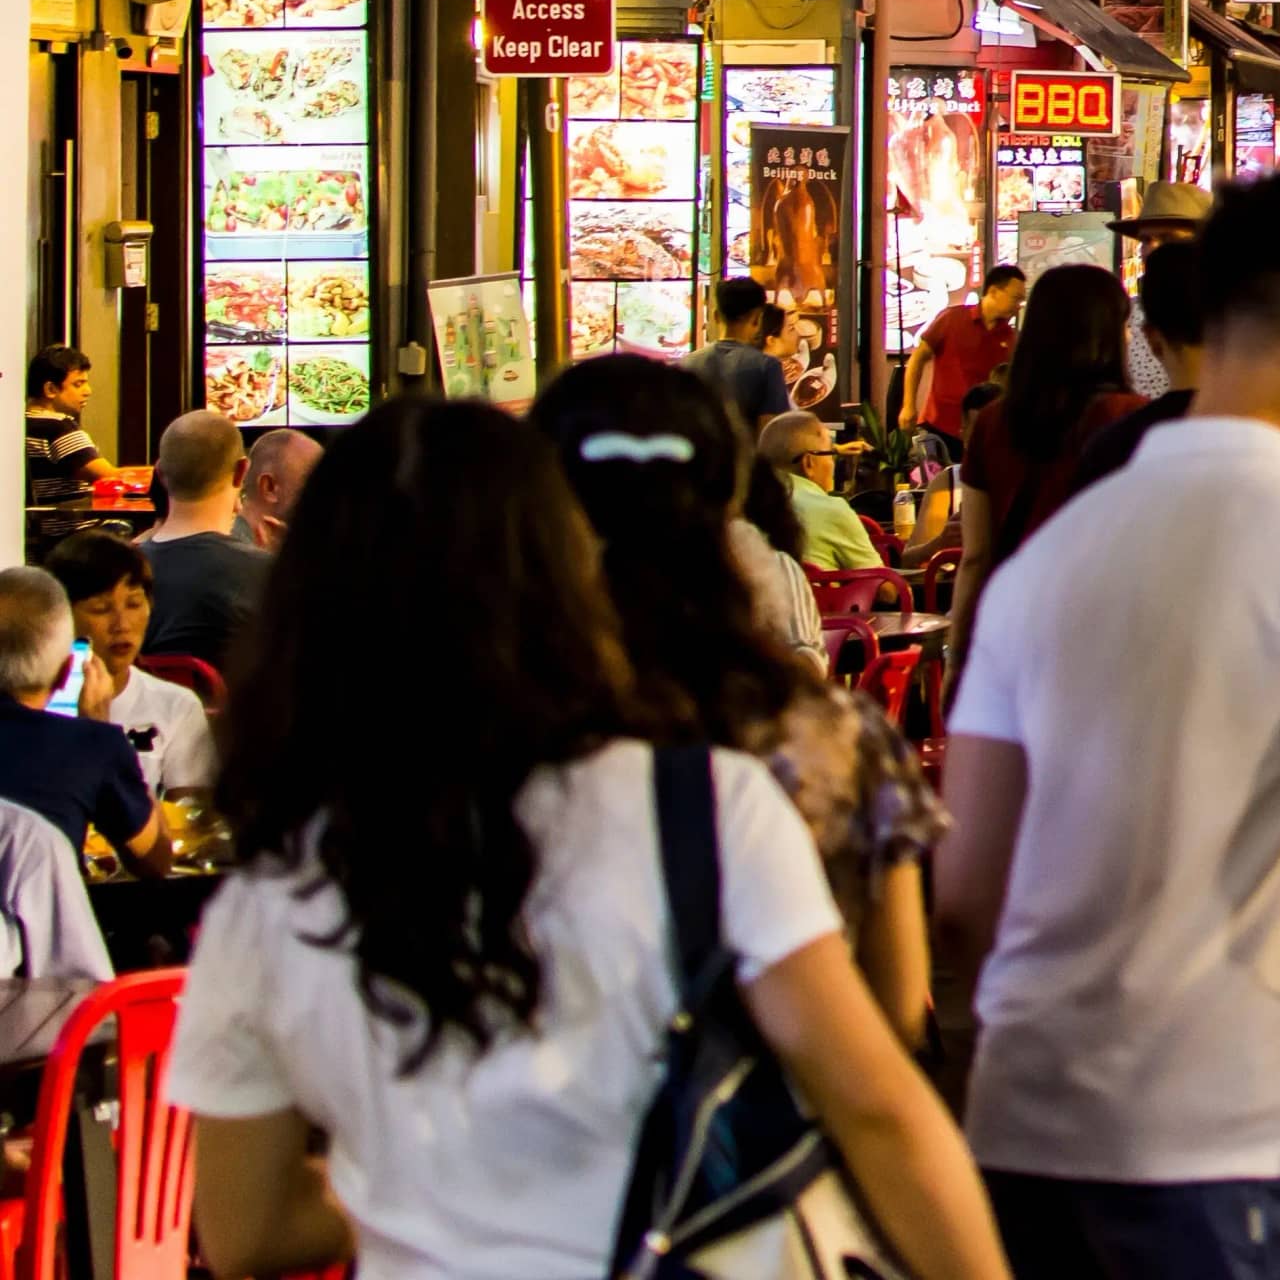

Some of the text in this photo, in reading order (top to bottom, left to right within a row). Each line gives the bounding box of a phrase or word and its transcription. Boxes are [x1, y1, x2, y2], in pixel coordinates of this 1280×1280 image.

[493, 36, 604, 62] Keep Clear
[1016, 83, 1110, 125] BBQ
[763, 166, 837, 182] Beijing Duck
